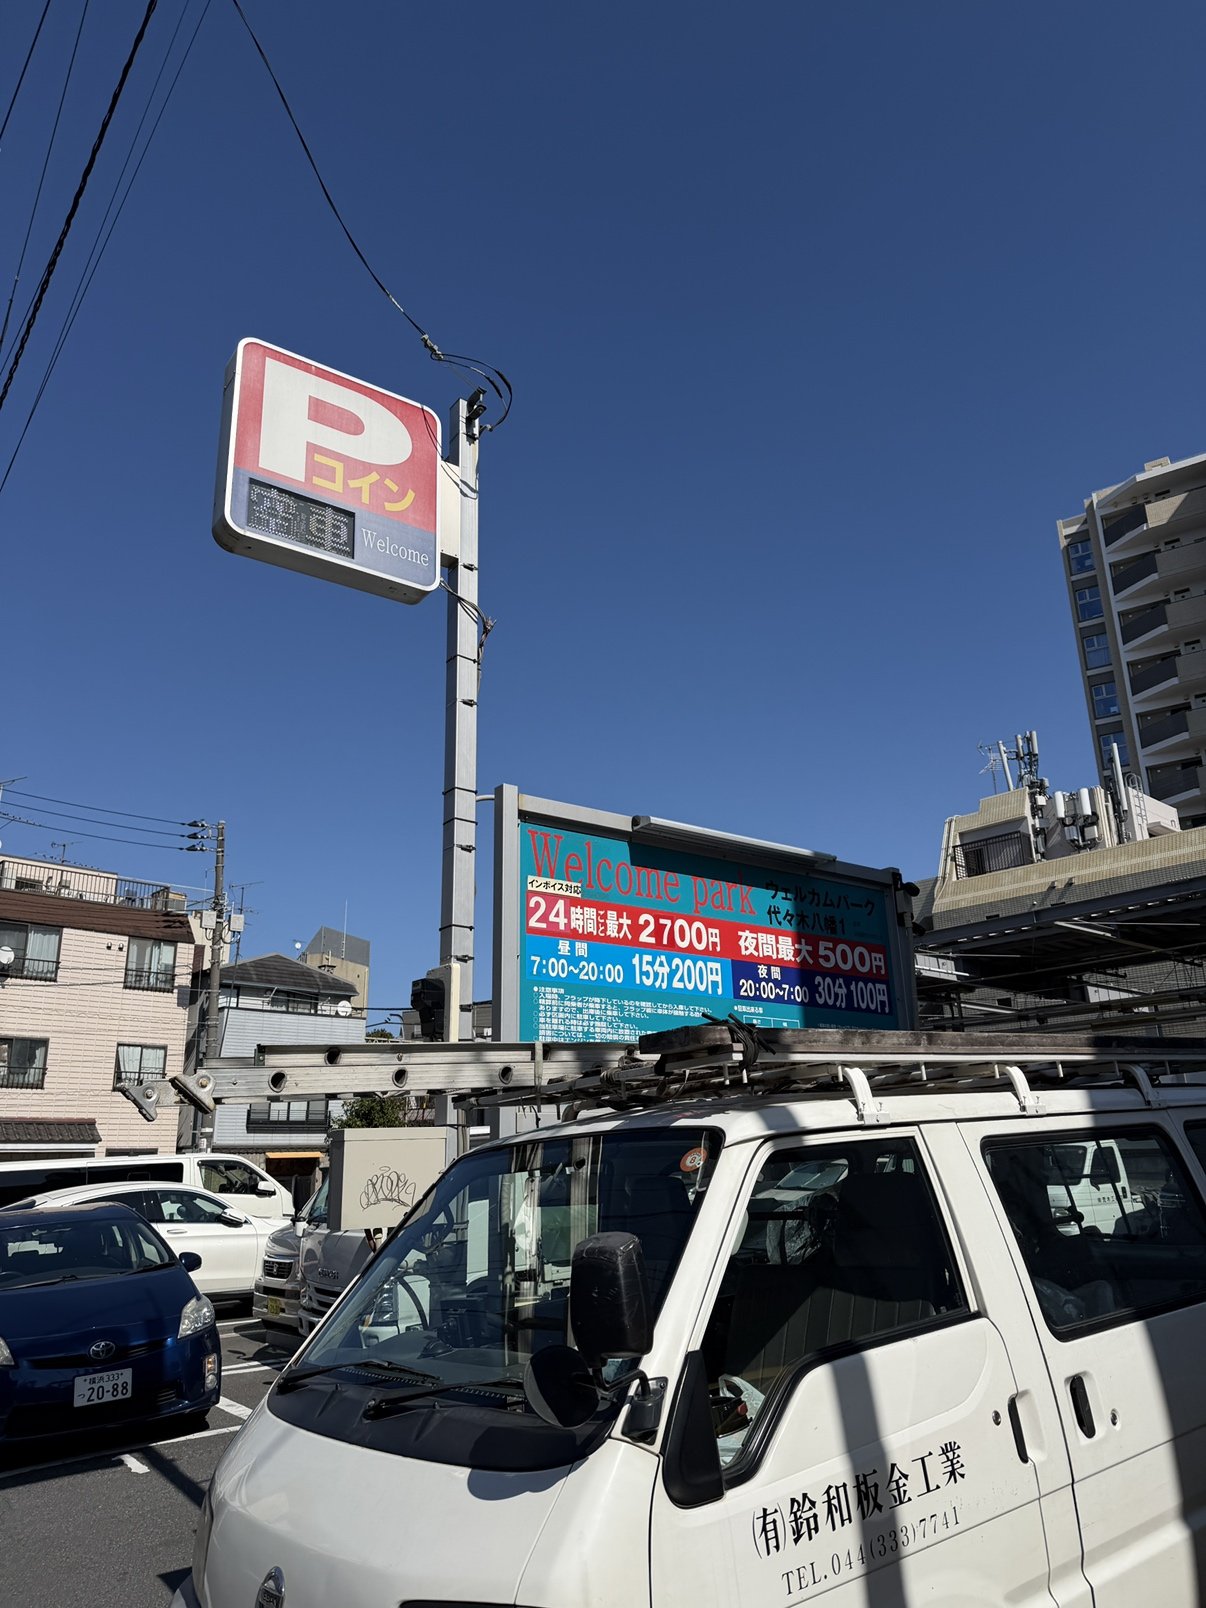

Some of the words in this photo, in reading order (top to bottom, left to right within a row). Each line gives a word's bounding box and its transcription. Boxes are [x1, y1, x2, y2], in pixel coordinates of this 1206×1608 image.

[258, 356, 413, 482] P
[312, 453, 416, 512] コイン
[361, 527, 429, 567] Welcome
[527, 829, 682, 903] Welcome
[692, 868, 757, 915] park
[528, 878, 582, 898] インボイス対応
[765, 879, 876, 917] ウェルカムパーク
[638, 912, 721, 953] 2700円
[737, 929, 814, 964] 夜間最大
[818, 941, 886, 976] 500円
[757, 964, 781, 981] 夜間
[86, 1381, 129, 1403] 20-88
